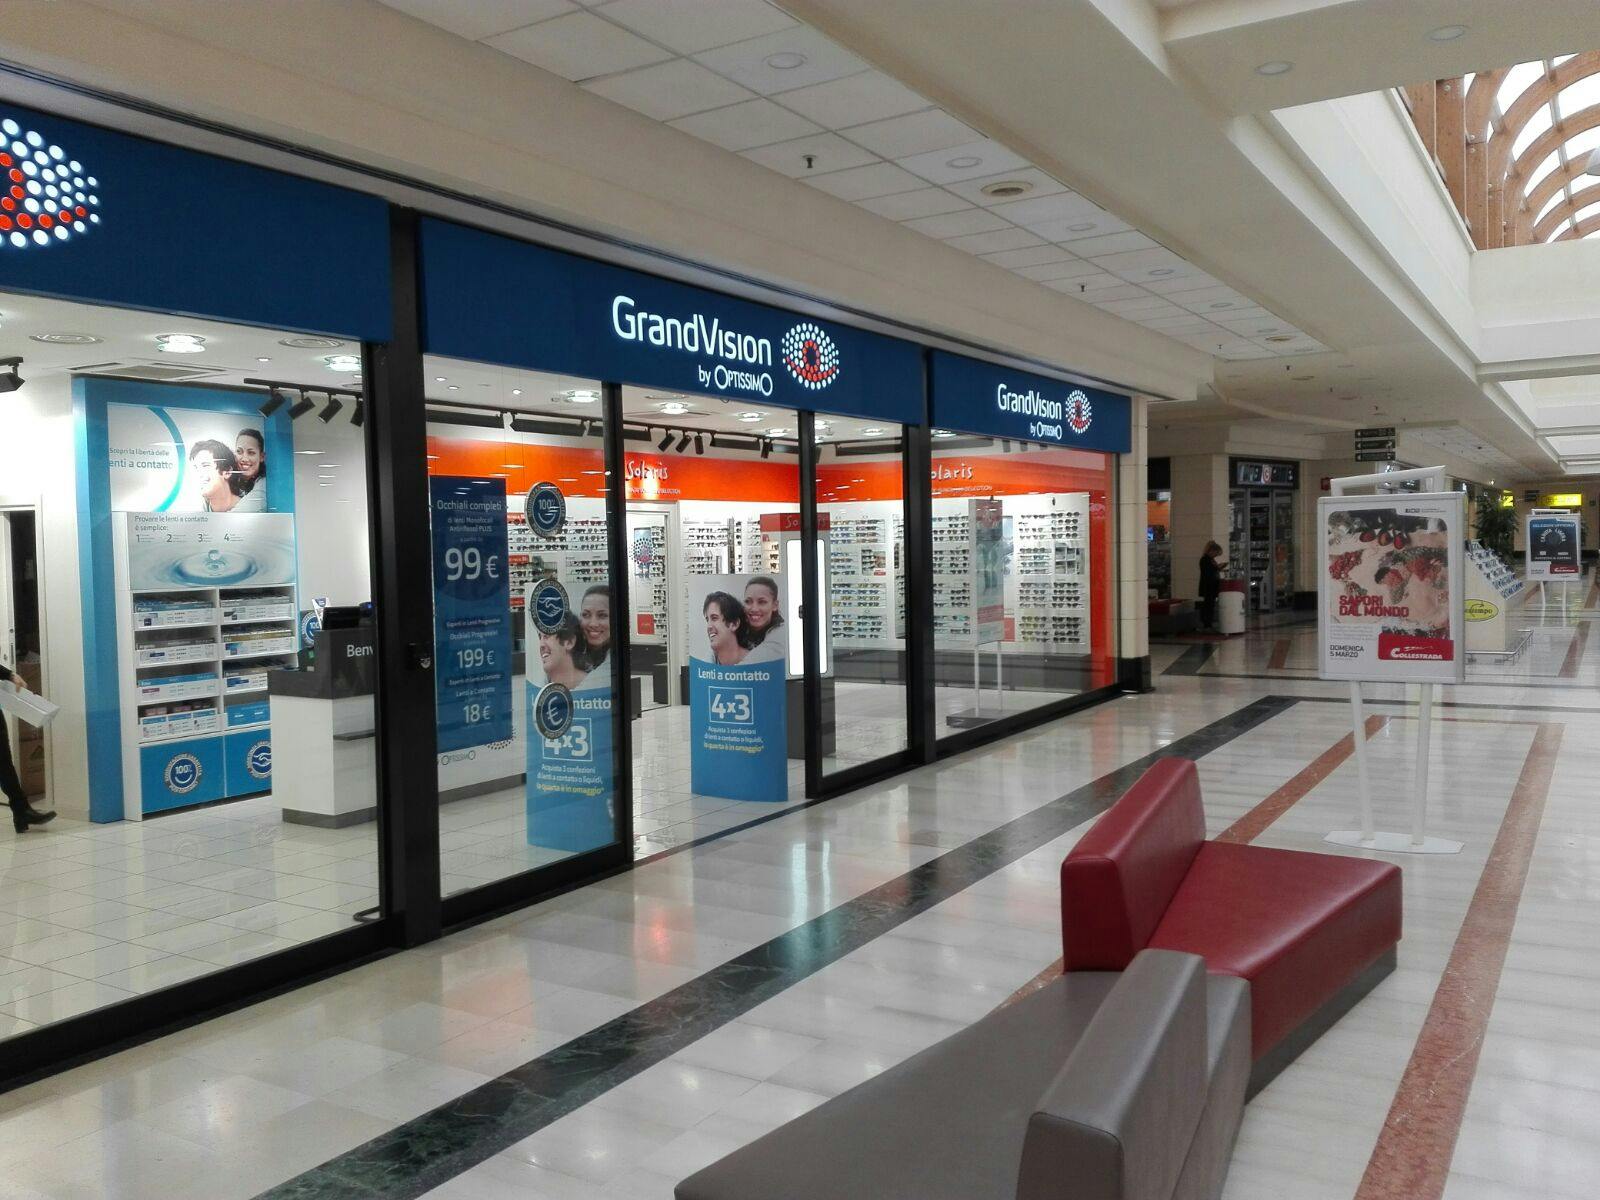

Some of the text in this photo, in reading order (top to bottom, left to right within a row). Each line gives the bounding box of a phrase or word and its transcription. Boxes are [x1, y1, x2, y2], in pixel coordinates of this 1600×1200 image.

[612, 295, 772, 366] GrandVision
[698, 364, 773, 397] by OPTISSIMO
[997, 383, 1063, 420] GrandVision
[1030, 422, 1036, 437] by
[109, 458, 126, 468] enti
[136, 459, 173, 470] contatto
[625, 460, 668, 480] Solaris
[931, 463, 973, 480] olaris
[437, 499, 502, 513] Occhiali completi
[136, 534, 140, 542] 1
[166, 533, 172, 543] 2
[198, 533, 203, 543] 3
[223, 533, 230, 542] 4
[445, 547, 499, 581] 99 €
[1339, 595, 1384, 606] SAPORI
[1339, 606, 1410, 618] DAL MONDO
[1330, 644, 1365, 652] DOMENICA
[1390, 647, 1443, 660] COLLESTRADA
[457, 648, 495, 669] 199 €
[698, 668, 770, 681] Lenti a contatto
[573, 697, 612, 710] ntatto
[711, 693, 751, 720] 4x3
[463, 704, 491, 724] 18 €
